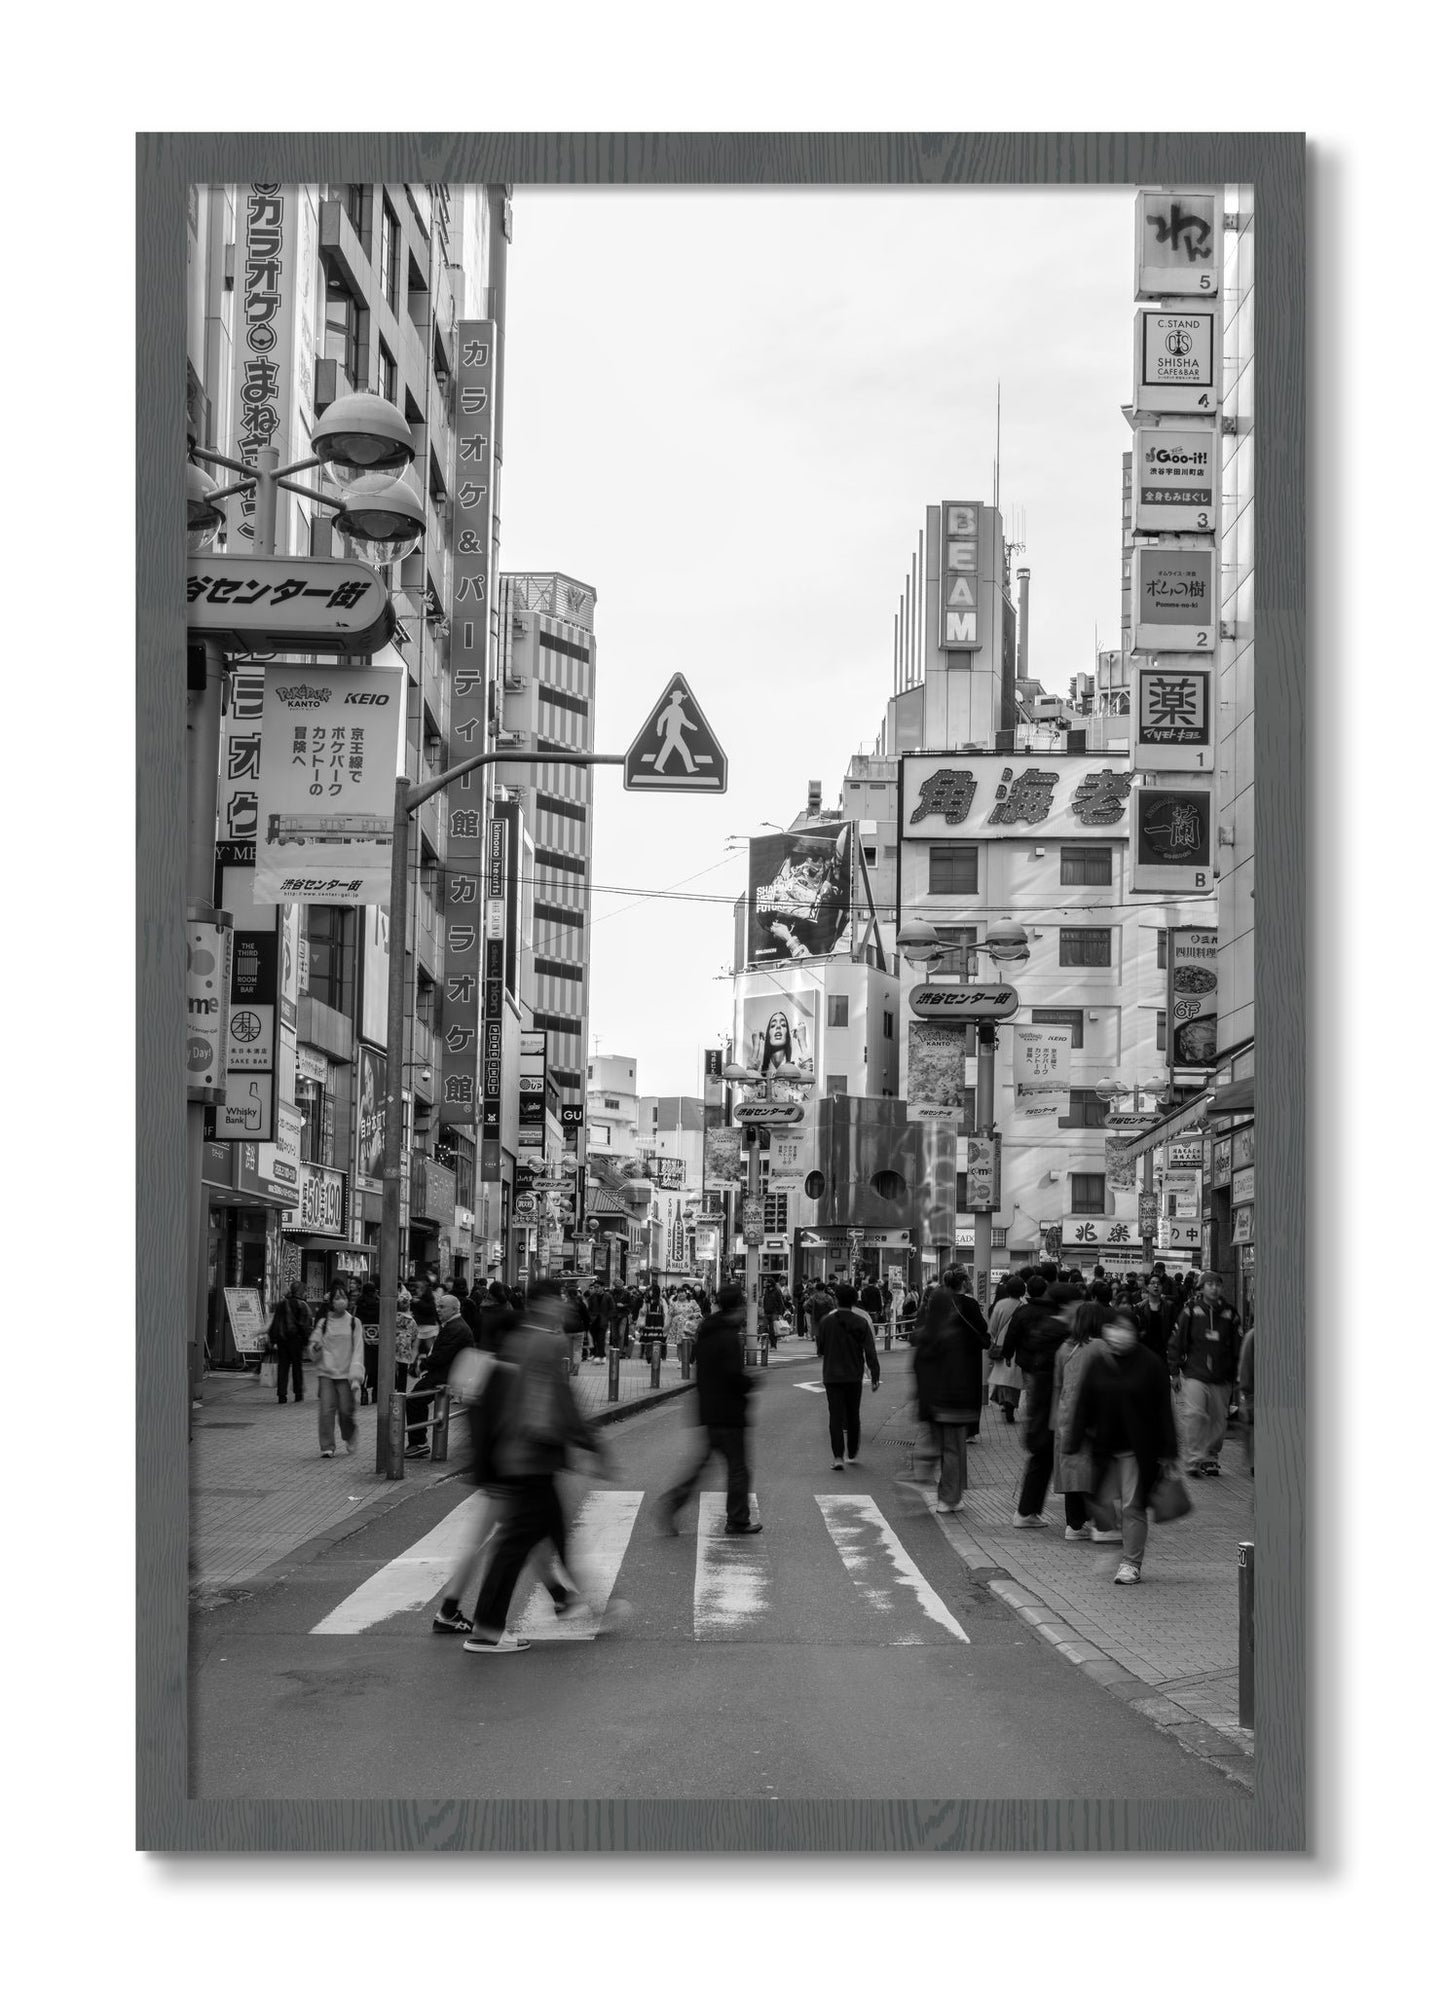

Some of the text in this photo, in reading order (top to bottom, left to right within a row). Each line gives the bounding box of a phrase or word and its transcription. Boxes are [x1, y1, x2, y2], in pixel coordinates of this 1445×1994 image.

[245, 196, 284, 324] カラオケ
[1199, 275, 1211, 289] 5
[1157, 319, 1200, 329] C.STAND
[1157, 357, 1200, 368] SHISHA
[1157, 368, 1200, 376] CAFE&BAR
[1198, 393, 1210, 408] 4
[1156, 449, 1208, 464] Goo-it!
[1145, 491, 1209, 503] 全身もみほぐし
[1197, 513, 1208, 527] 3
[948, 505, 978, 644] BEAM
[1197, 632, 1208, 646] 2
[344, 693, 390, 706] KEIO
[1149, 678, 1196, 725] 薬
[1144, 728, 1202, 742] マツモトキヨシ
[292, 726, 307, 767] 冒険へ
[309, 726, 326, 797] カントーの
[349, 727, 365, 783] 京王線で
[1196, 752, 1204, 766] 1
[1144, 804, 1201, 850] 一蘭
[493, 823, 501, 857] kimono
[492, 861, 502, 894] hearts
[1195, 872, 1206, 887] B
[280, 879, 363, 891] 渋谷センター街
[1175, 947, 1217, 958] 四川料理
[916, 993, 1012, 1004] 渋谷センター街
[1174, 1001, 1201, 1019] 6F
[193, 1047, 212, 1059] Day!
[226, 1107, 257, 1119] Whisky
[563, 1110, 582, 1120] GU
[737, 1107, 796, 1116] 渋谷センター街
[225, 1116, 245, 1124] Bank
[674, 1221, 683, 1260] BEER
